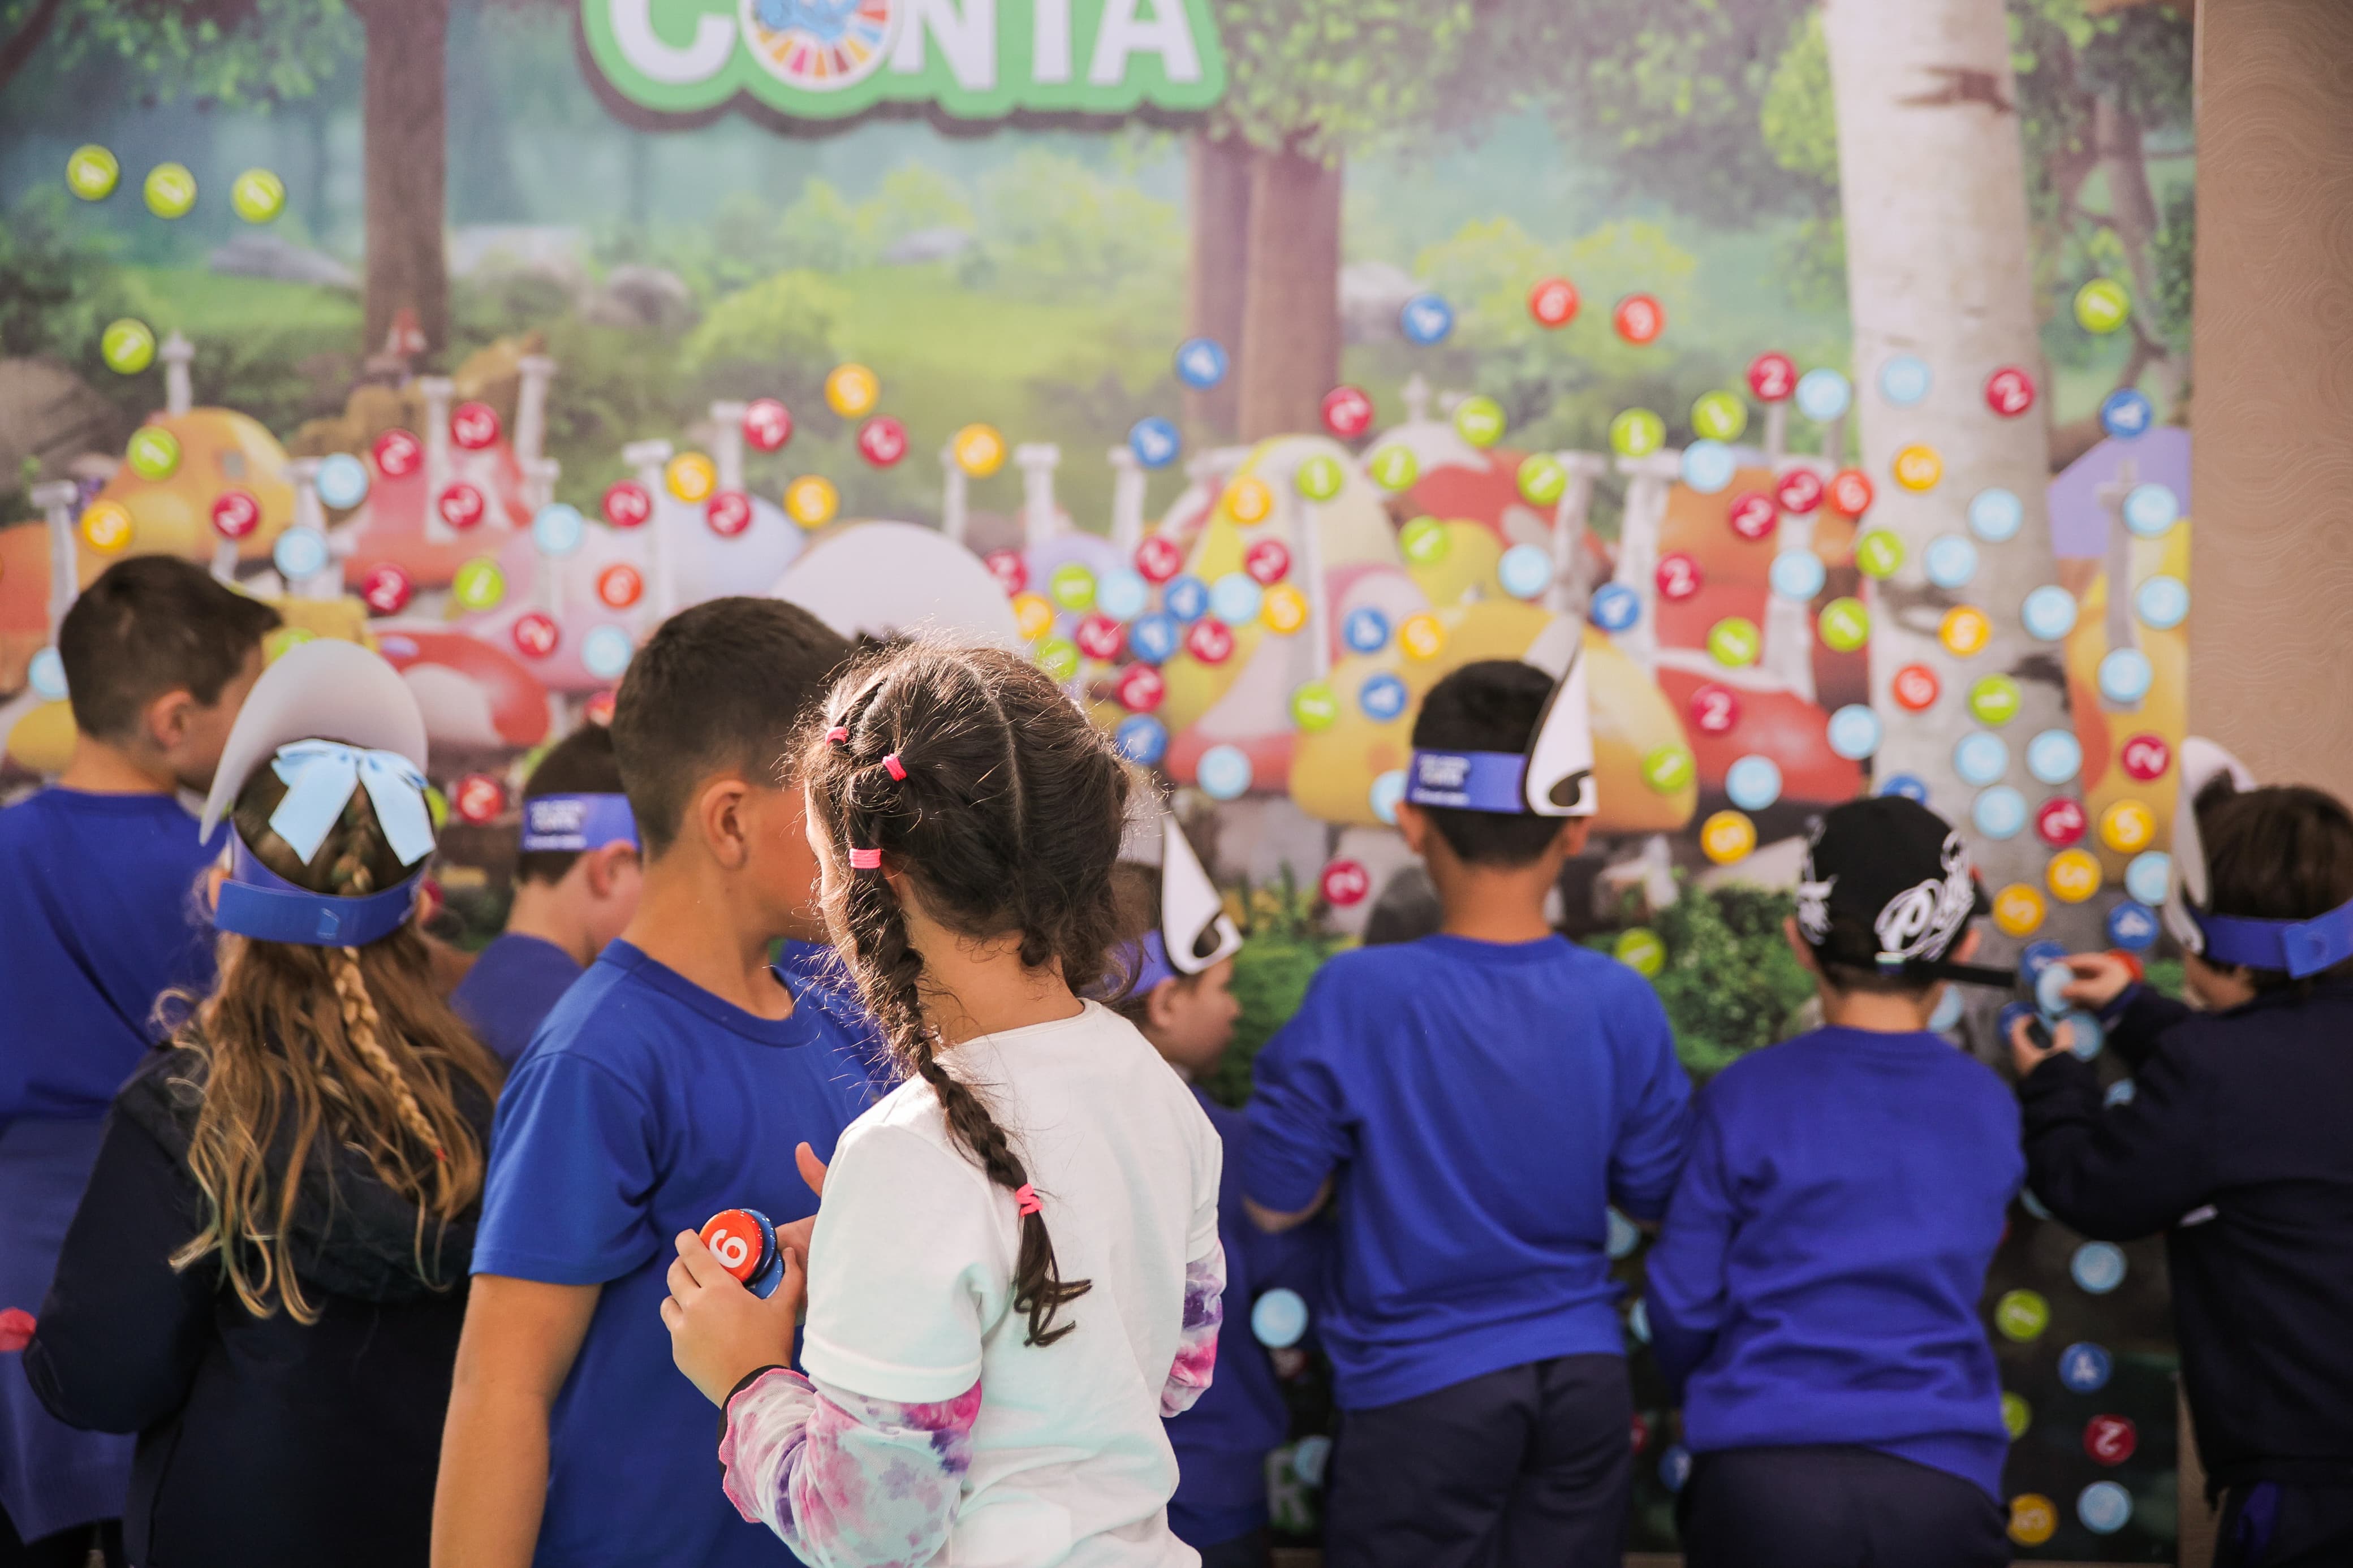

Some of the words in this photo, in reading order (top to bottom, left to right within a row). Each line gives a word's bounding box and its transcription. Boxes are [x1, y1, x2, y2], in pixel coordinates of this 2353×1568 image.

[1759, 358, 1789, 396] 2
[1993, 373, 2030, 412] 2
[1661, 558, 1695, 596] 2
[1701, 692, 1731, 729] 2
[2128, 744, 2167, 772] 2
[2115, 807, 2142, 843] 5
[709, 1229, 748, 1268] 6
[2074, 1354, 2096, 1381] 4
[2097, 1422, 2123, 1455] 2
